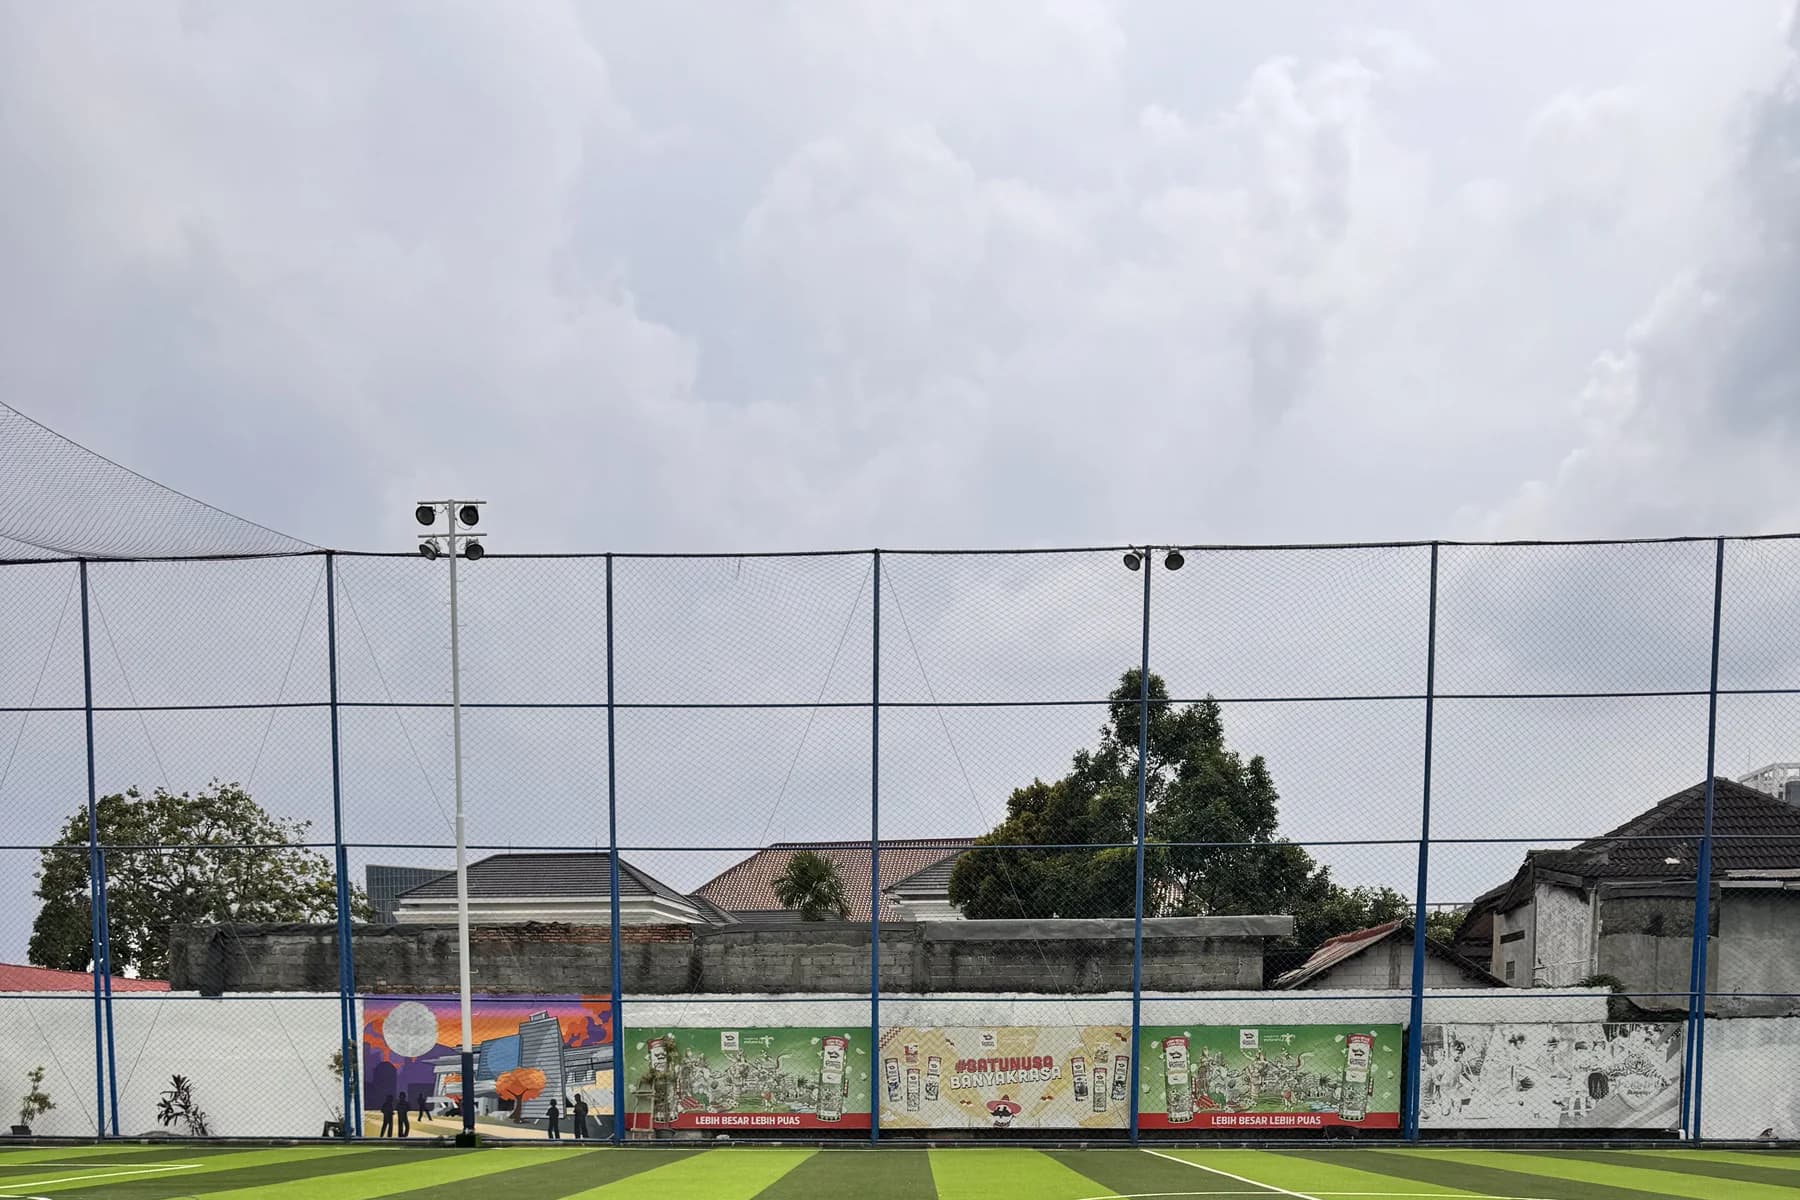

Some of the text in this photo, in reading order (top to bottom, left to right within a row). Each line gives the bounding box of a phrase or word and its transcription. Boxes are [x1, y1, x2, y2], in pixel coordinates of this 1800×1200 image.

[954, 1055, 1054, 1074] #SATUNUSA
[949, 1065, 1063, 1090] BANYAKRASA
[695, 1115, 801, 1125] LEBIH BESAR LEBIH PUAS
[1211, 1115, 1321, 1125] LEBIH BESAR LEBIH PUAS
